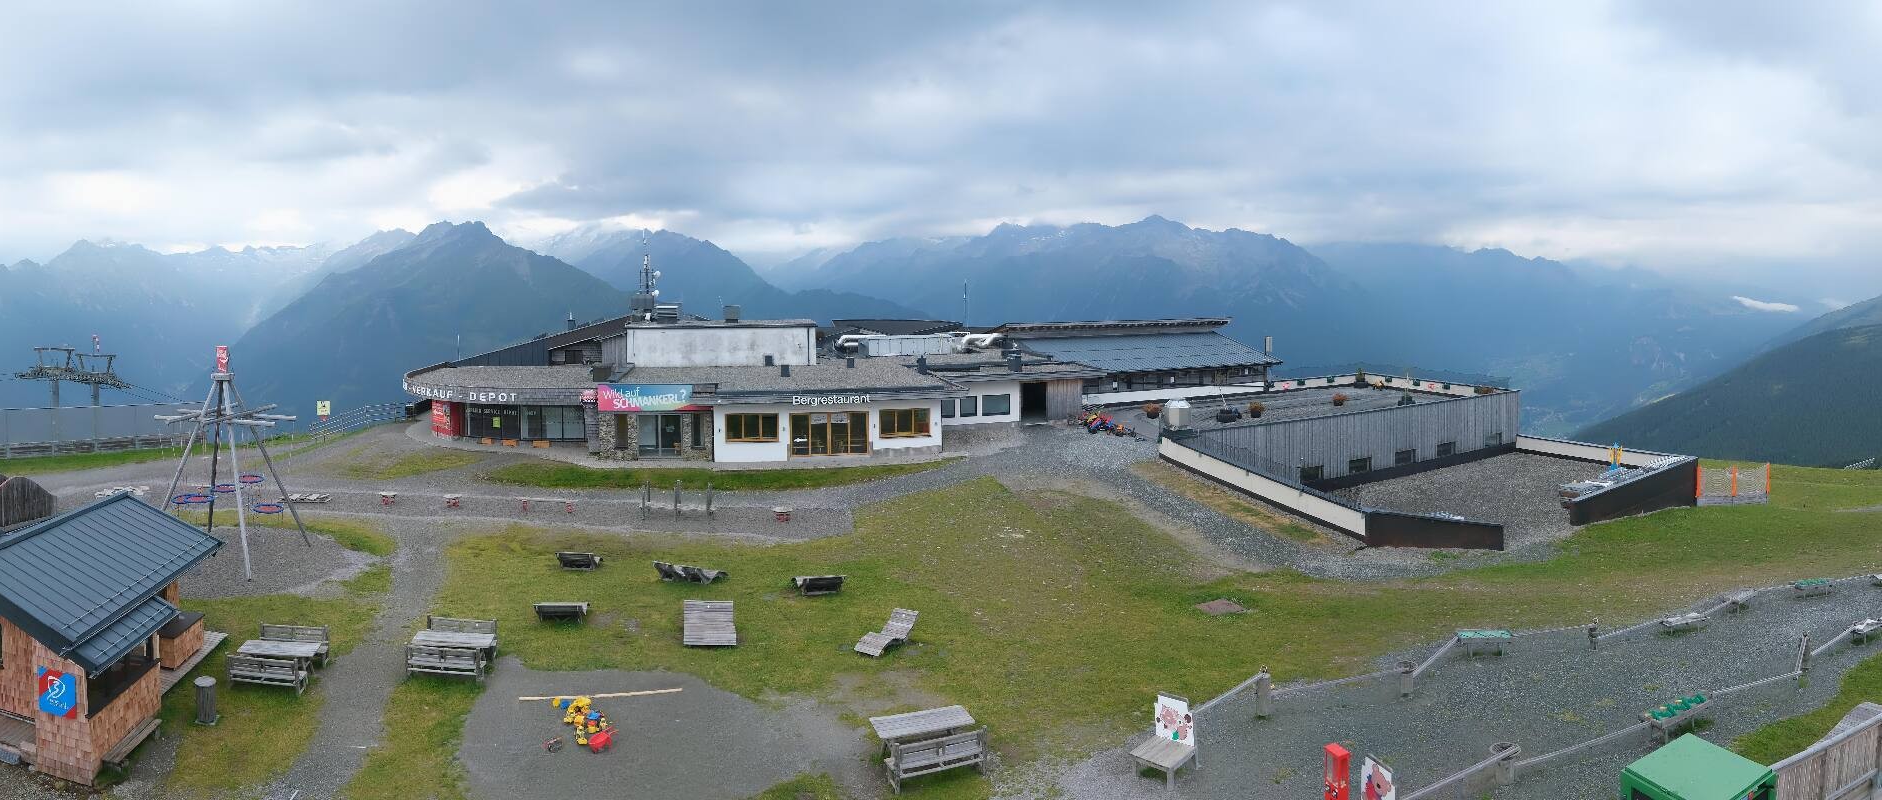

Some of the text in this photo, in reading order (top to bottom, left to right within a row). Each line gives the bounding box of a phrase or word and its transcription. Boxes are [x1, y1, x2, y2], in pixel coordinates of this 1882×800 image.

[412, 385, 453, 399] VERKAUF
[469, 391, 518, 402] DEPOT
[602, 388, 623, 400] Wild
[625, 386, 641, 397] auf
[612, 389, 687, 409] SCHMANKERL?
[793, 394, 871, 405] Bergrestaurant
